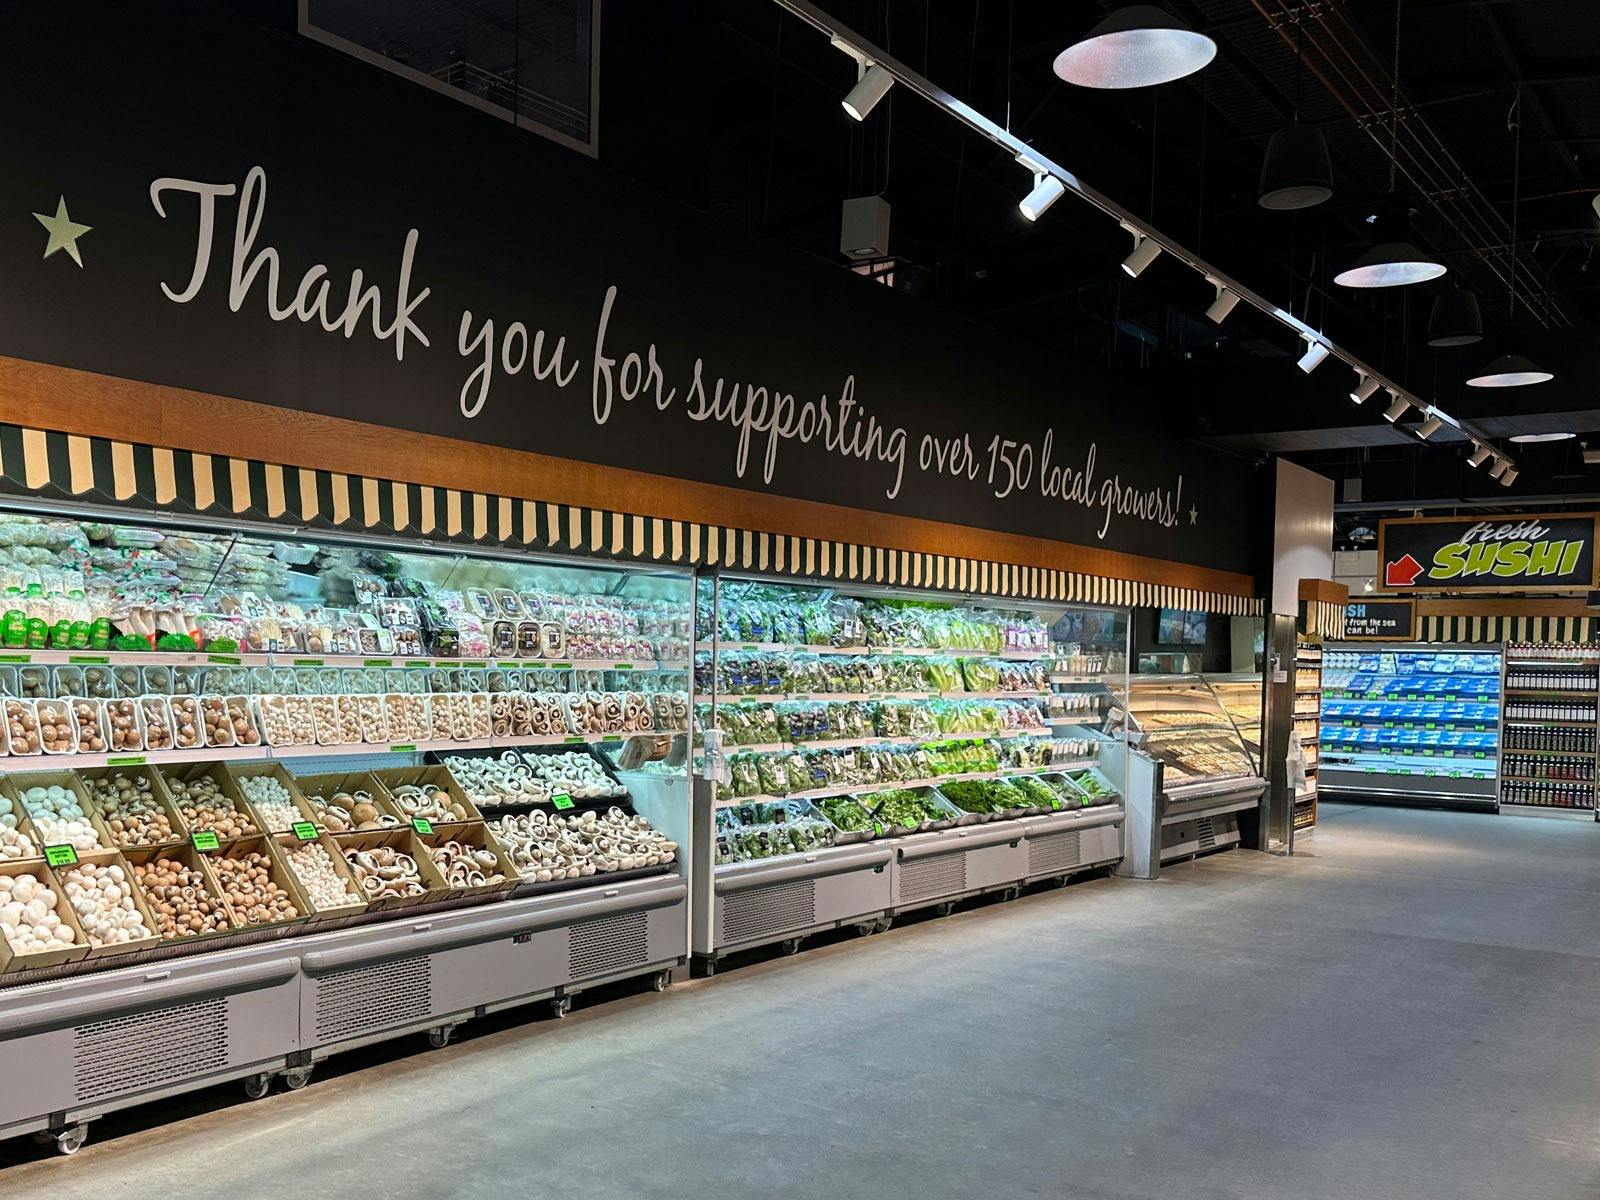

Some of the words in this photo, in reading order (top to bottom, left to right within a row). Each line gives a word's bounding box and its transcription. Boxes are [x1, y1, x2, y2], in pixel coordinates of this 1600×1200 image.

[149, 165, 431, 363] Thank
[458, 310, 580, 419] you
[592, 285, 677, 425] for
[685, 358, 909, 500] supporting
[919, 432, 981, 481] over
[987, 434, 1033, 499] 150
[1040, 428, 1097, 508] local
[1096, 474, 1183, 540] growers!
[1458, 518, 1550, 547] fresh
[1427, 539, 1585, 580] SUSHI
[1344, 604, 1366, 618] SH
[1349, 618, 1368, 626] from
[1369, 618, 1381, 626] the
